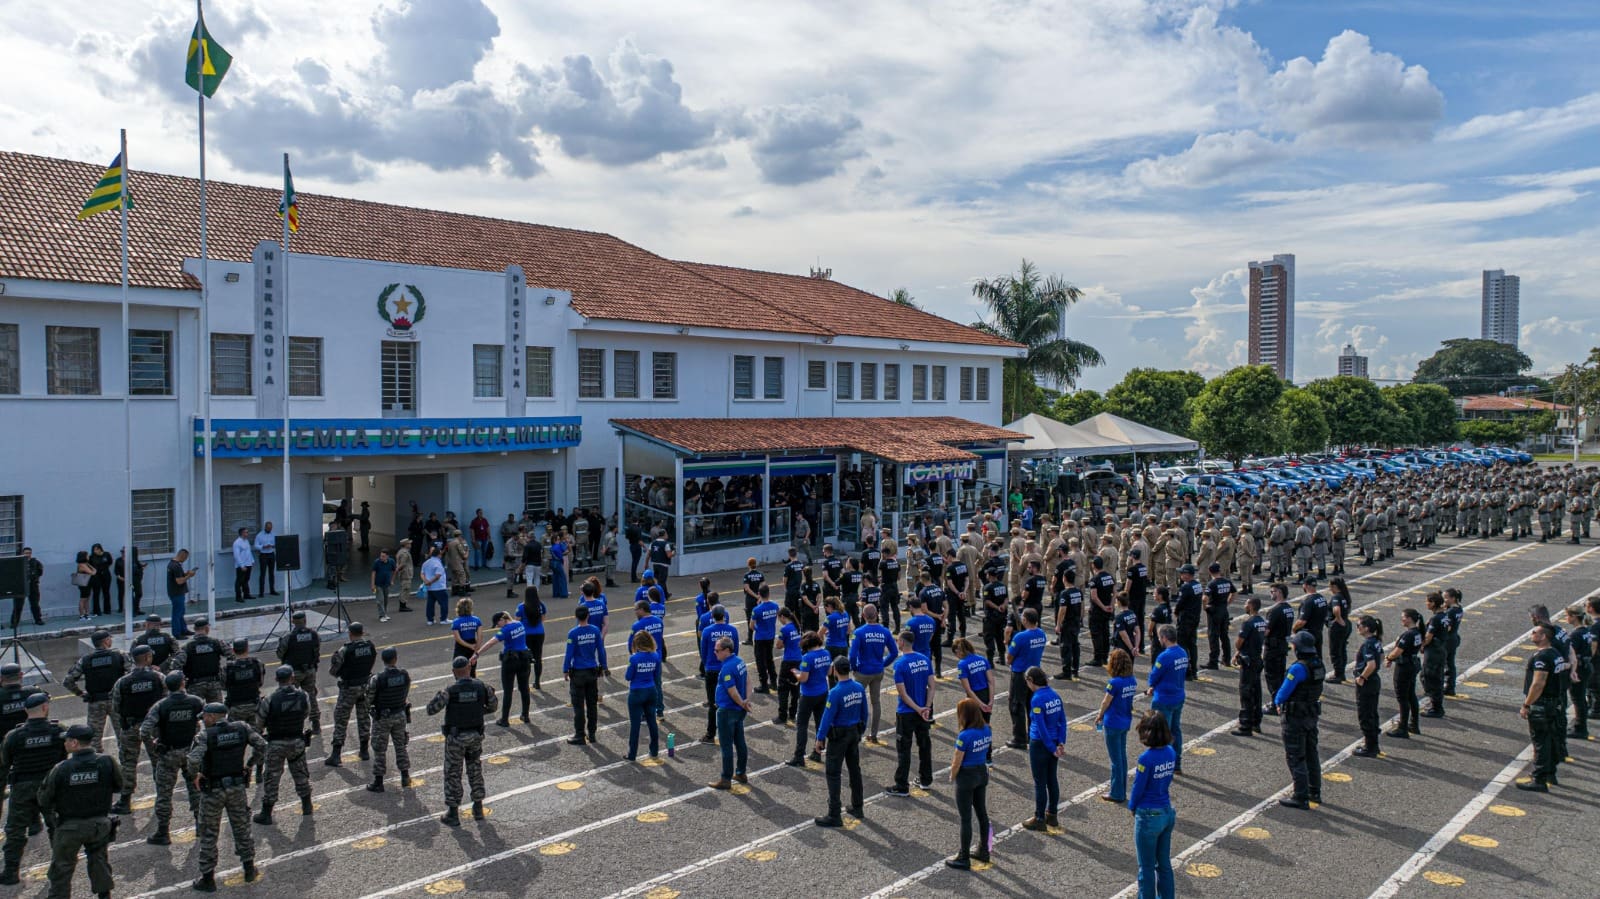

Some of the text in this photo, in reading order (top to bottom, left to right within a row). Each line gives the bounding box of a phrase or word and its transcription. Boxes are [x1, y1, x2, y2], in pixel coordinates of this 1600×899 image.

[264, 251, 274, 385] HIERARQUIA
[381, 427, 412, 447] DE
[420, 418, 509, 447] POLÍCIA
[515, 423, 582, 444] MILITAR
[912, 462, 969, 481] CAPM
[577, 632, 596, 640] POLÍCIA
[843, 690, 862, 702] POLÍCIA
[26, 736, 51, 745] GTAE
[71, 772, 97, 781] GTAE
